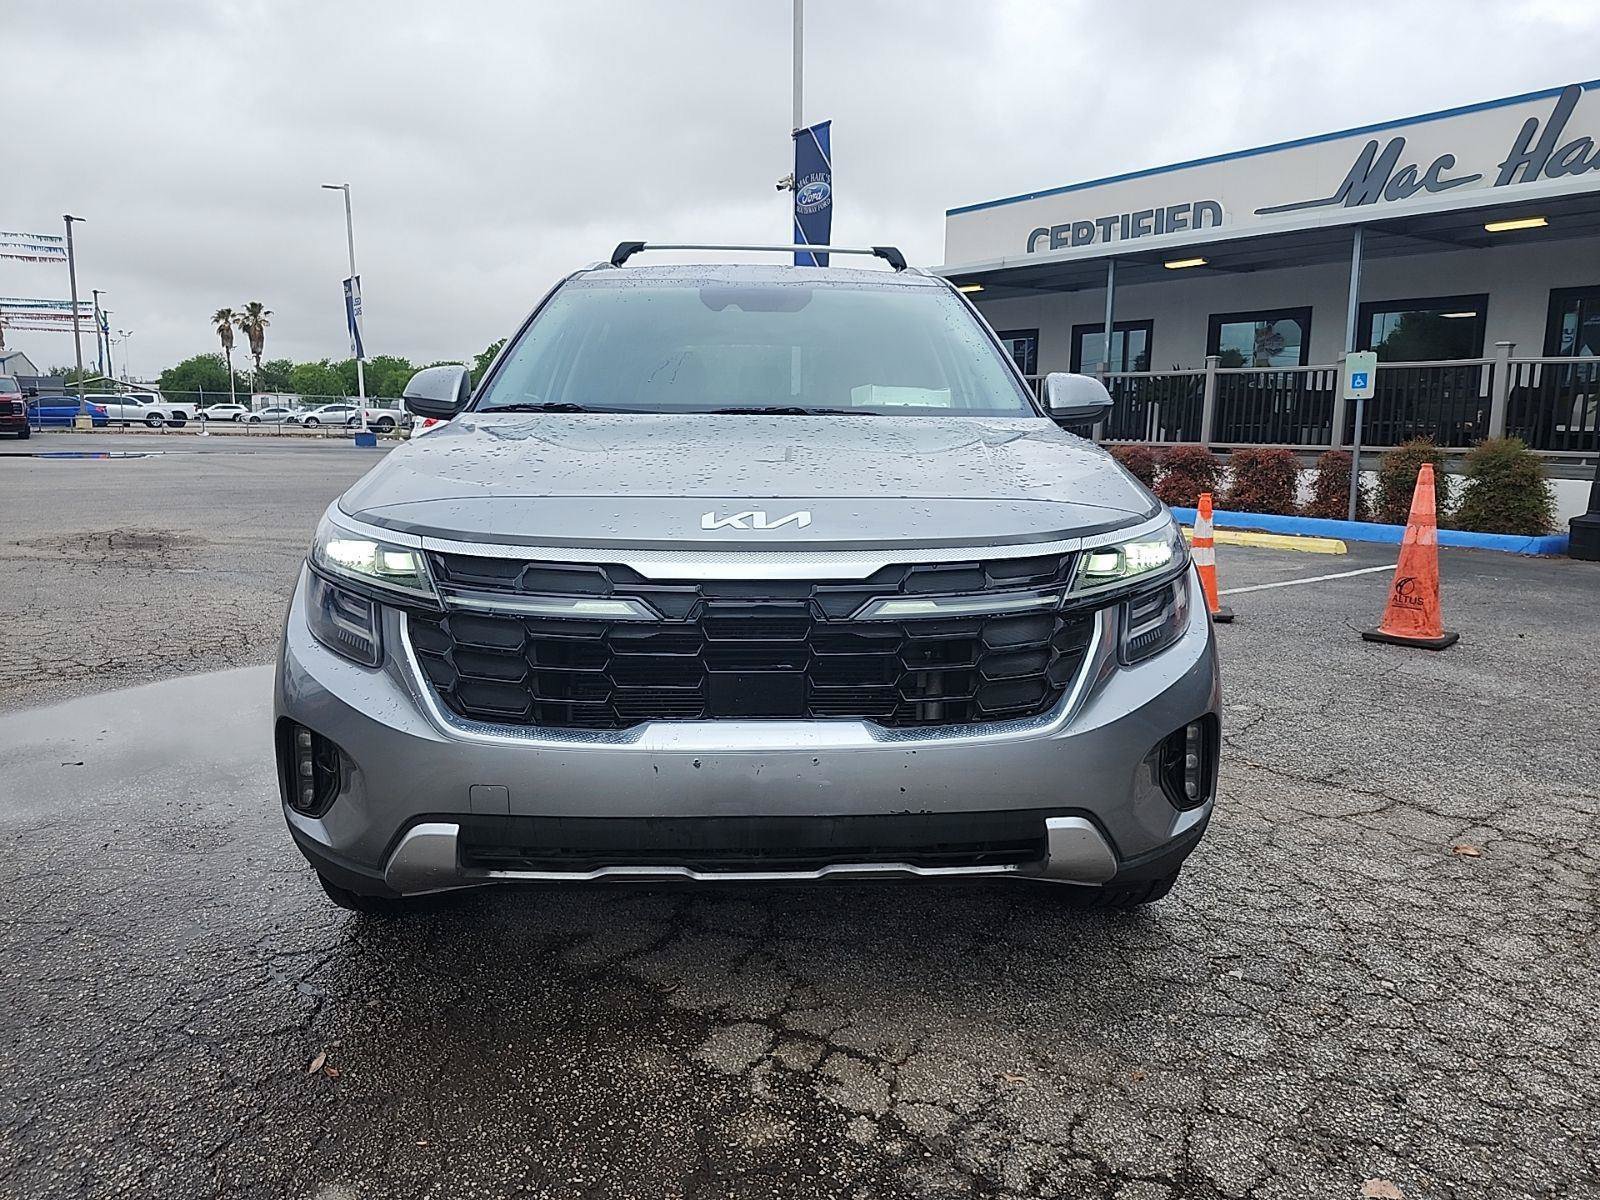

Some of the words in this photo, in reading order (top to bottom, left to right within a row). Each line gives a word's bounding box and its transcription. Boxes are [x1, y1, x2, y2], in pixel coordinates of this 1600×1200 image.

[1254, 137, 1482, 215] Mac
[1494, 84, 1600, 188] Ha
[801, 187, 823, 204] Ford
[1026, 200, 1223, 254] CERTIFIED
[701, 511, 811, 530] KIA
[1392, 594, 1424, 606] ALTUS
